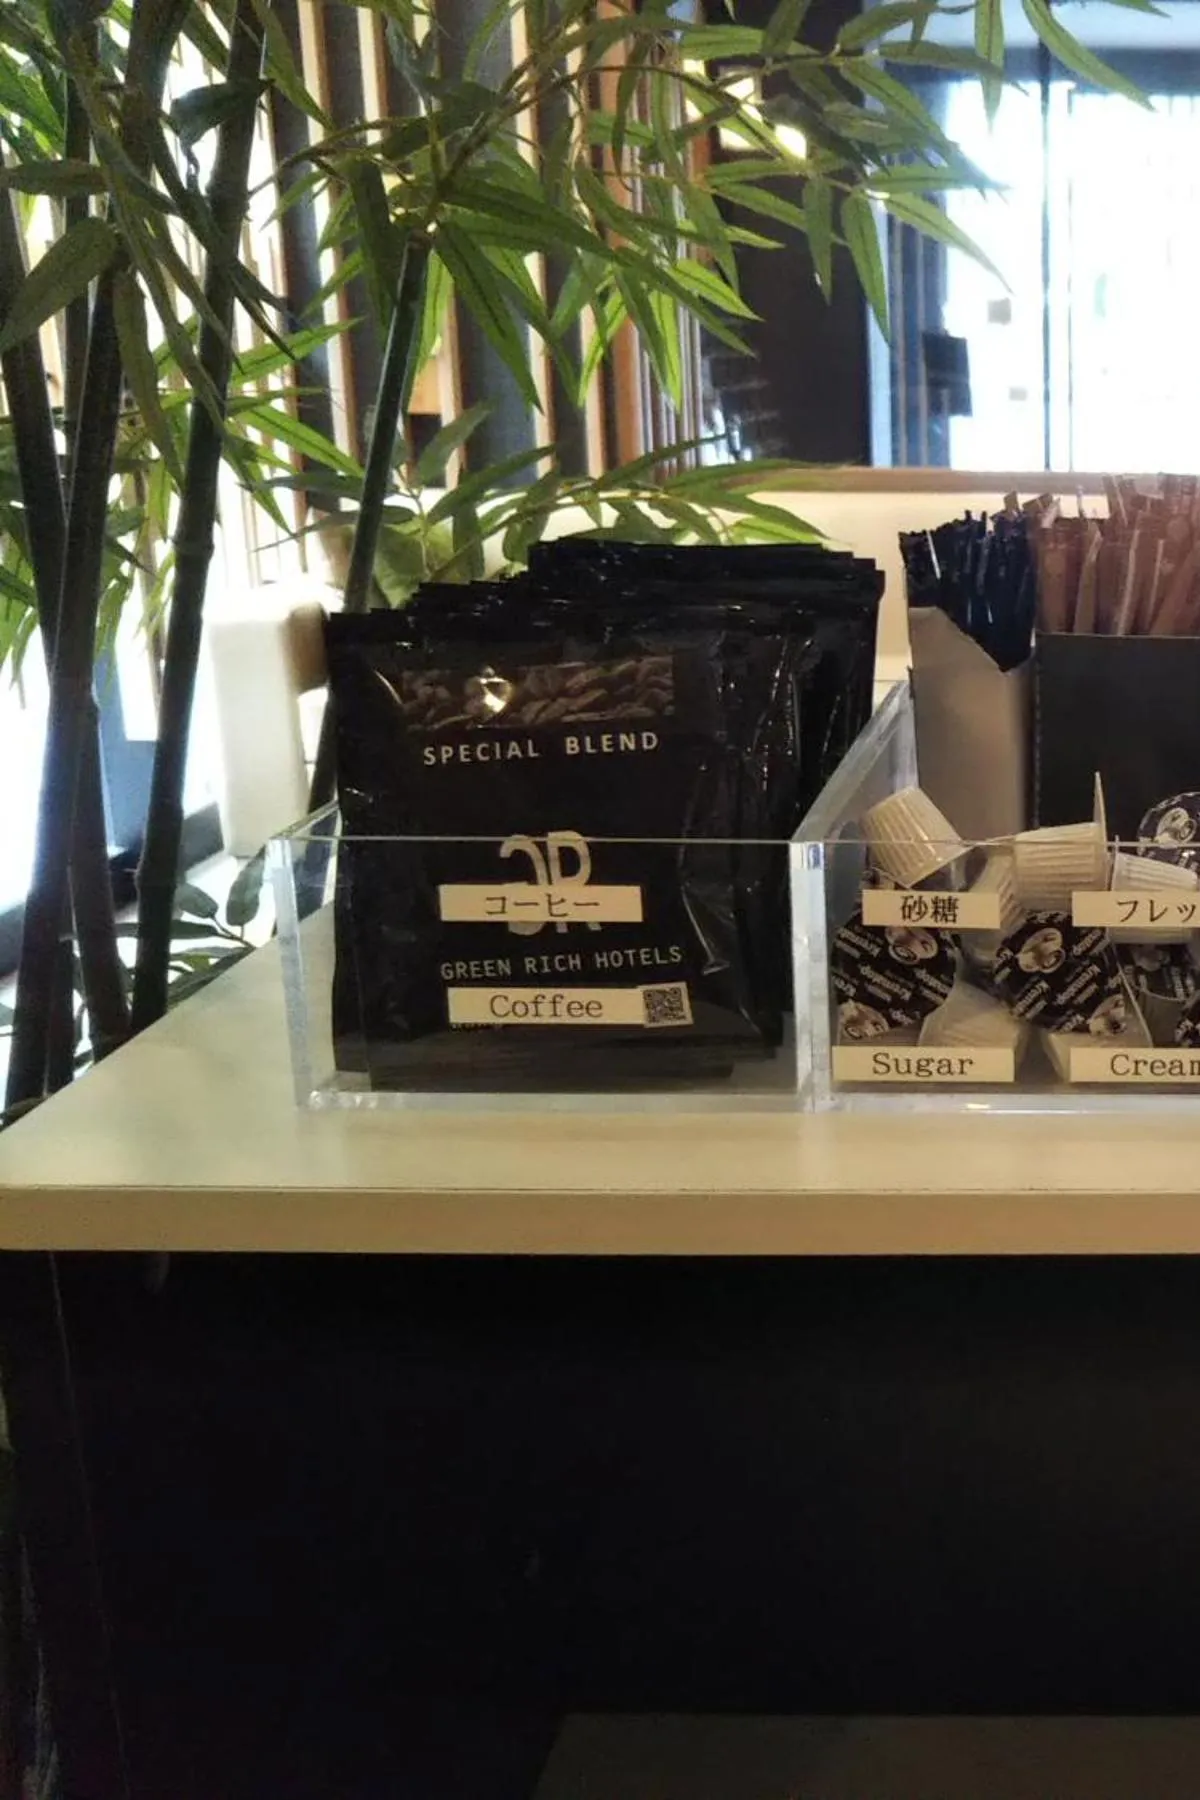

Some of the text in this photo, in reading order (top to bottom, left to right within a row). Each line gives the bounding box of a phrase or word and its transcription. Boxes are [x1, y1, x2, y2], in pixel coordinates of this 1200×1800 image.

[423, 731, 659, 766] SPECIAL BLEND
[485, 893, 600, 918] コーヒー
[899, 895, 960, 924] 砂糖
[439, 945, 683, 981] GREEN RICH HOTELS
[489, 993, 603, 1019] Coffee
[871, 1052, 974, 1078] Sugar
